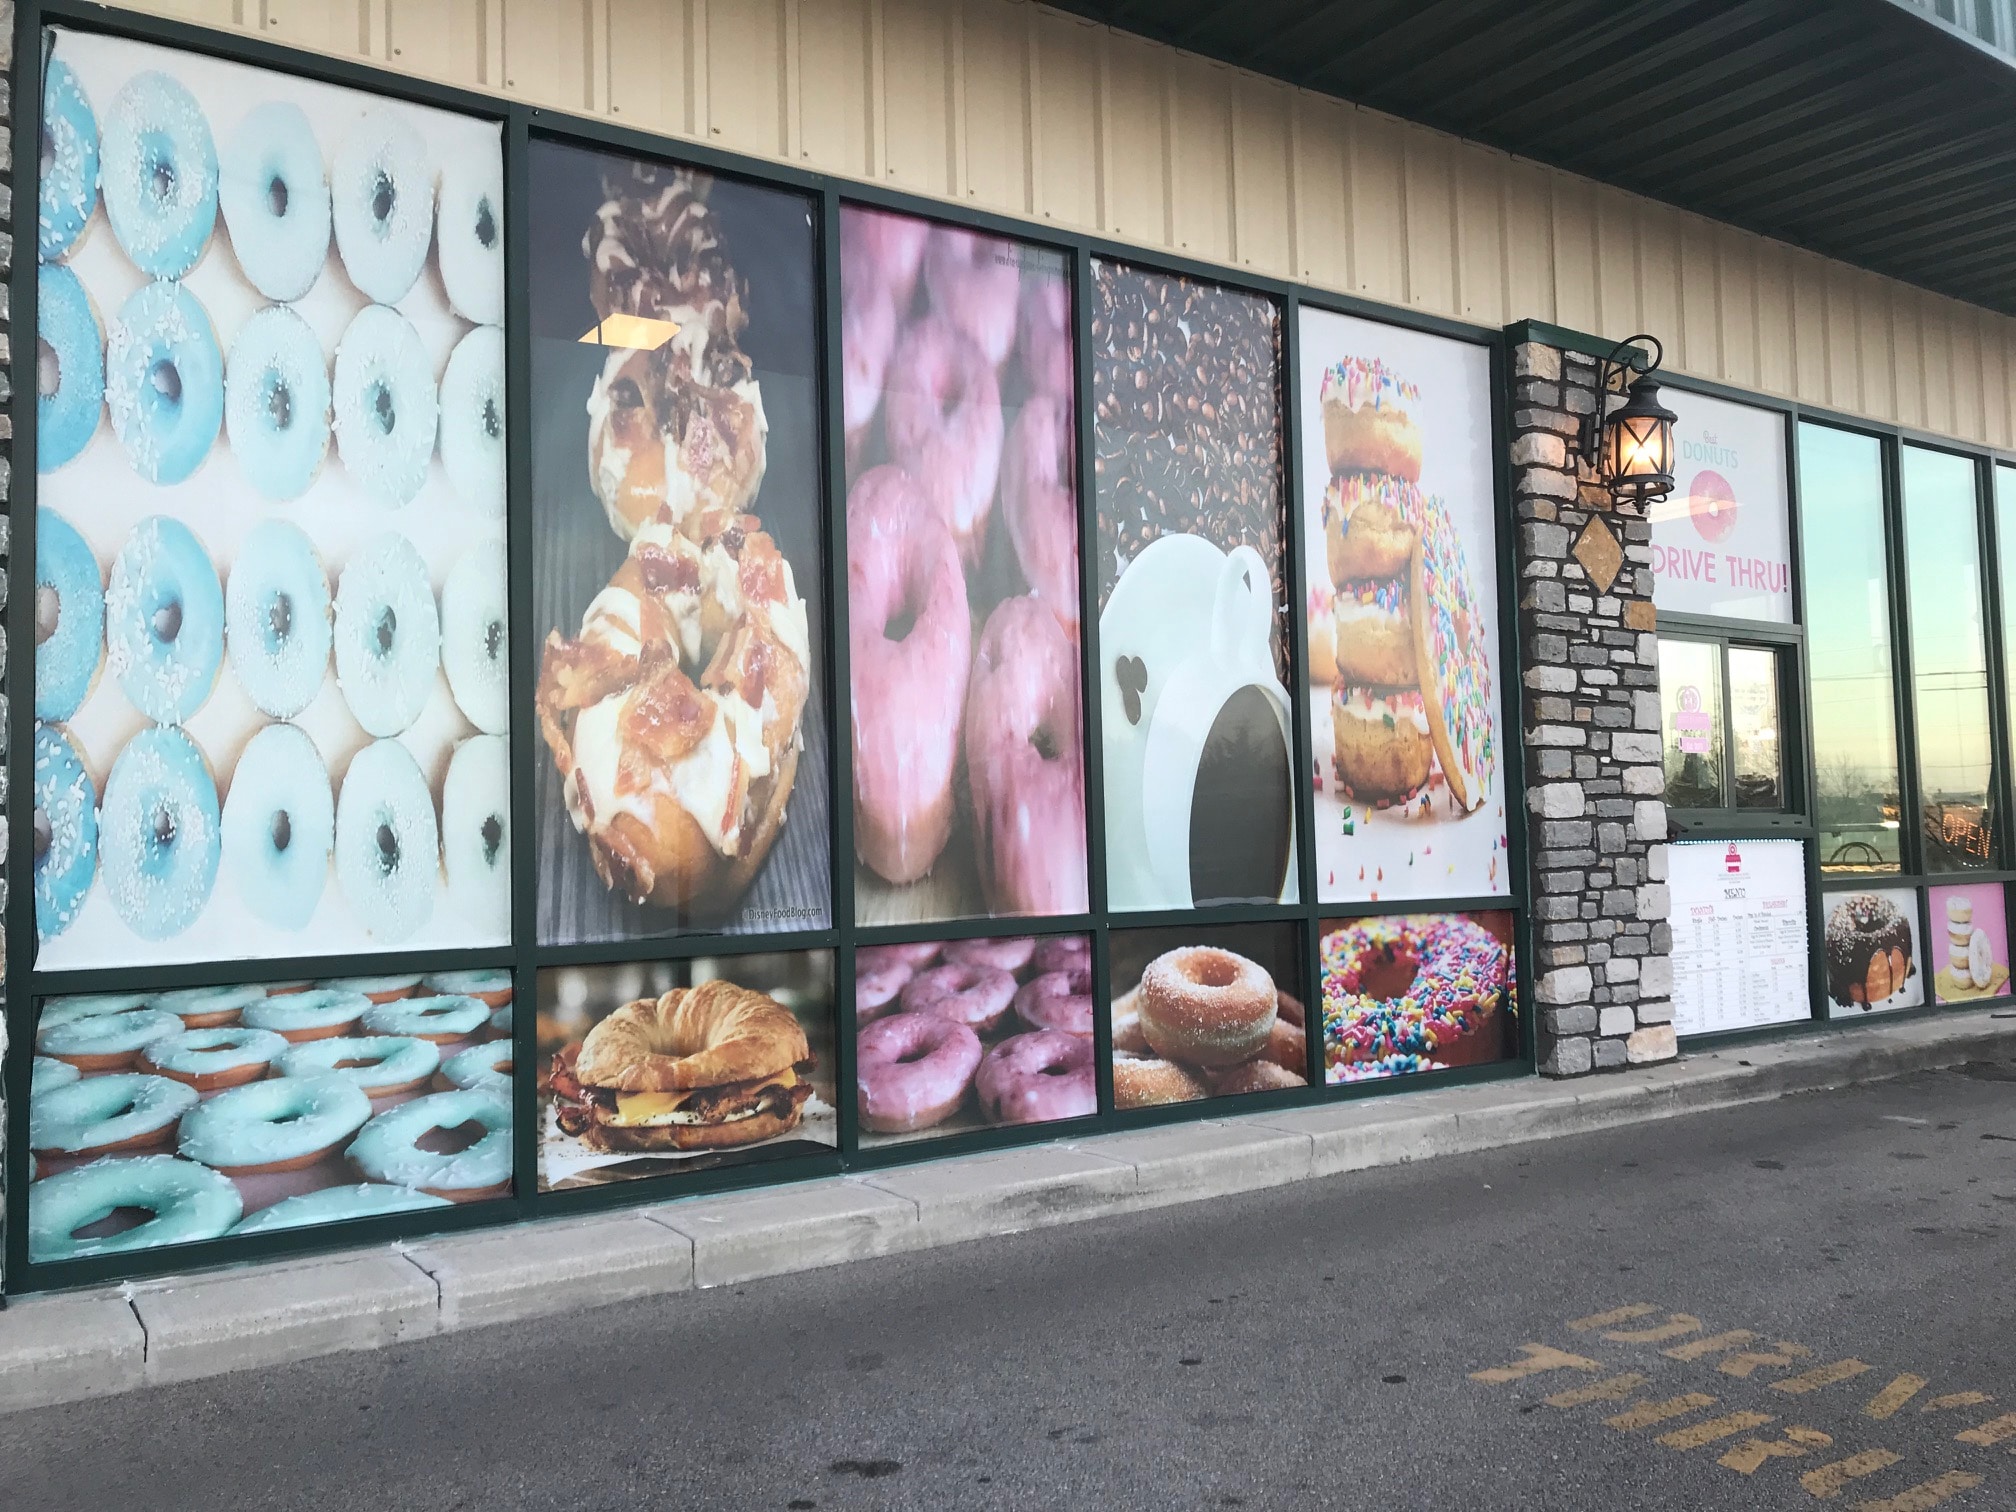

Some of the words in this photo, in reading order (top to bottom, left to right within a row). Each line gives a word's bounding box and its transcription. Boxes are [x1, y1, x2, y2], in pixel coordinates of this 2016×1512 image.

[1683, 440, 1739, 469] DONUTS
[1702, 430, 1719, 445] Best
[1651, 544, 1717, 583] DRIVE
[1725, 555, 1788, 593] THRU!
[1942, 813, 1991, 859] OPEN
